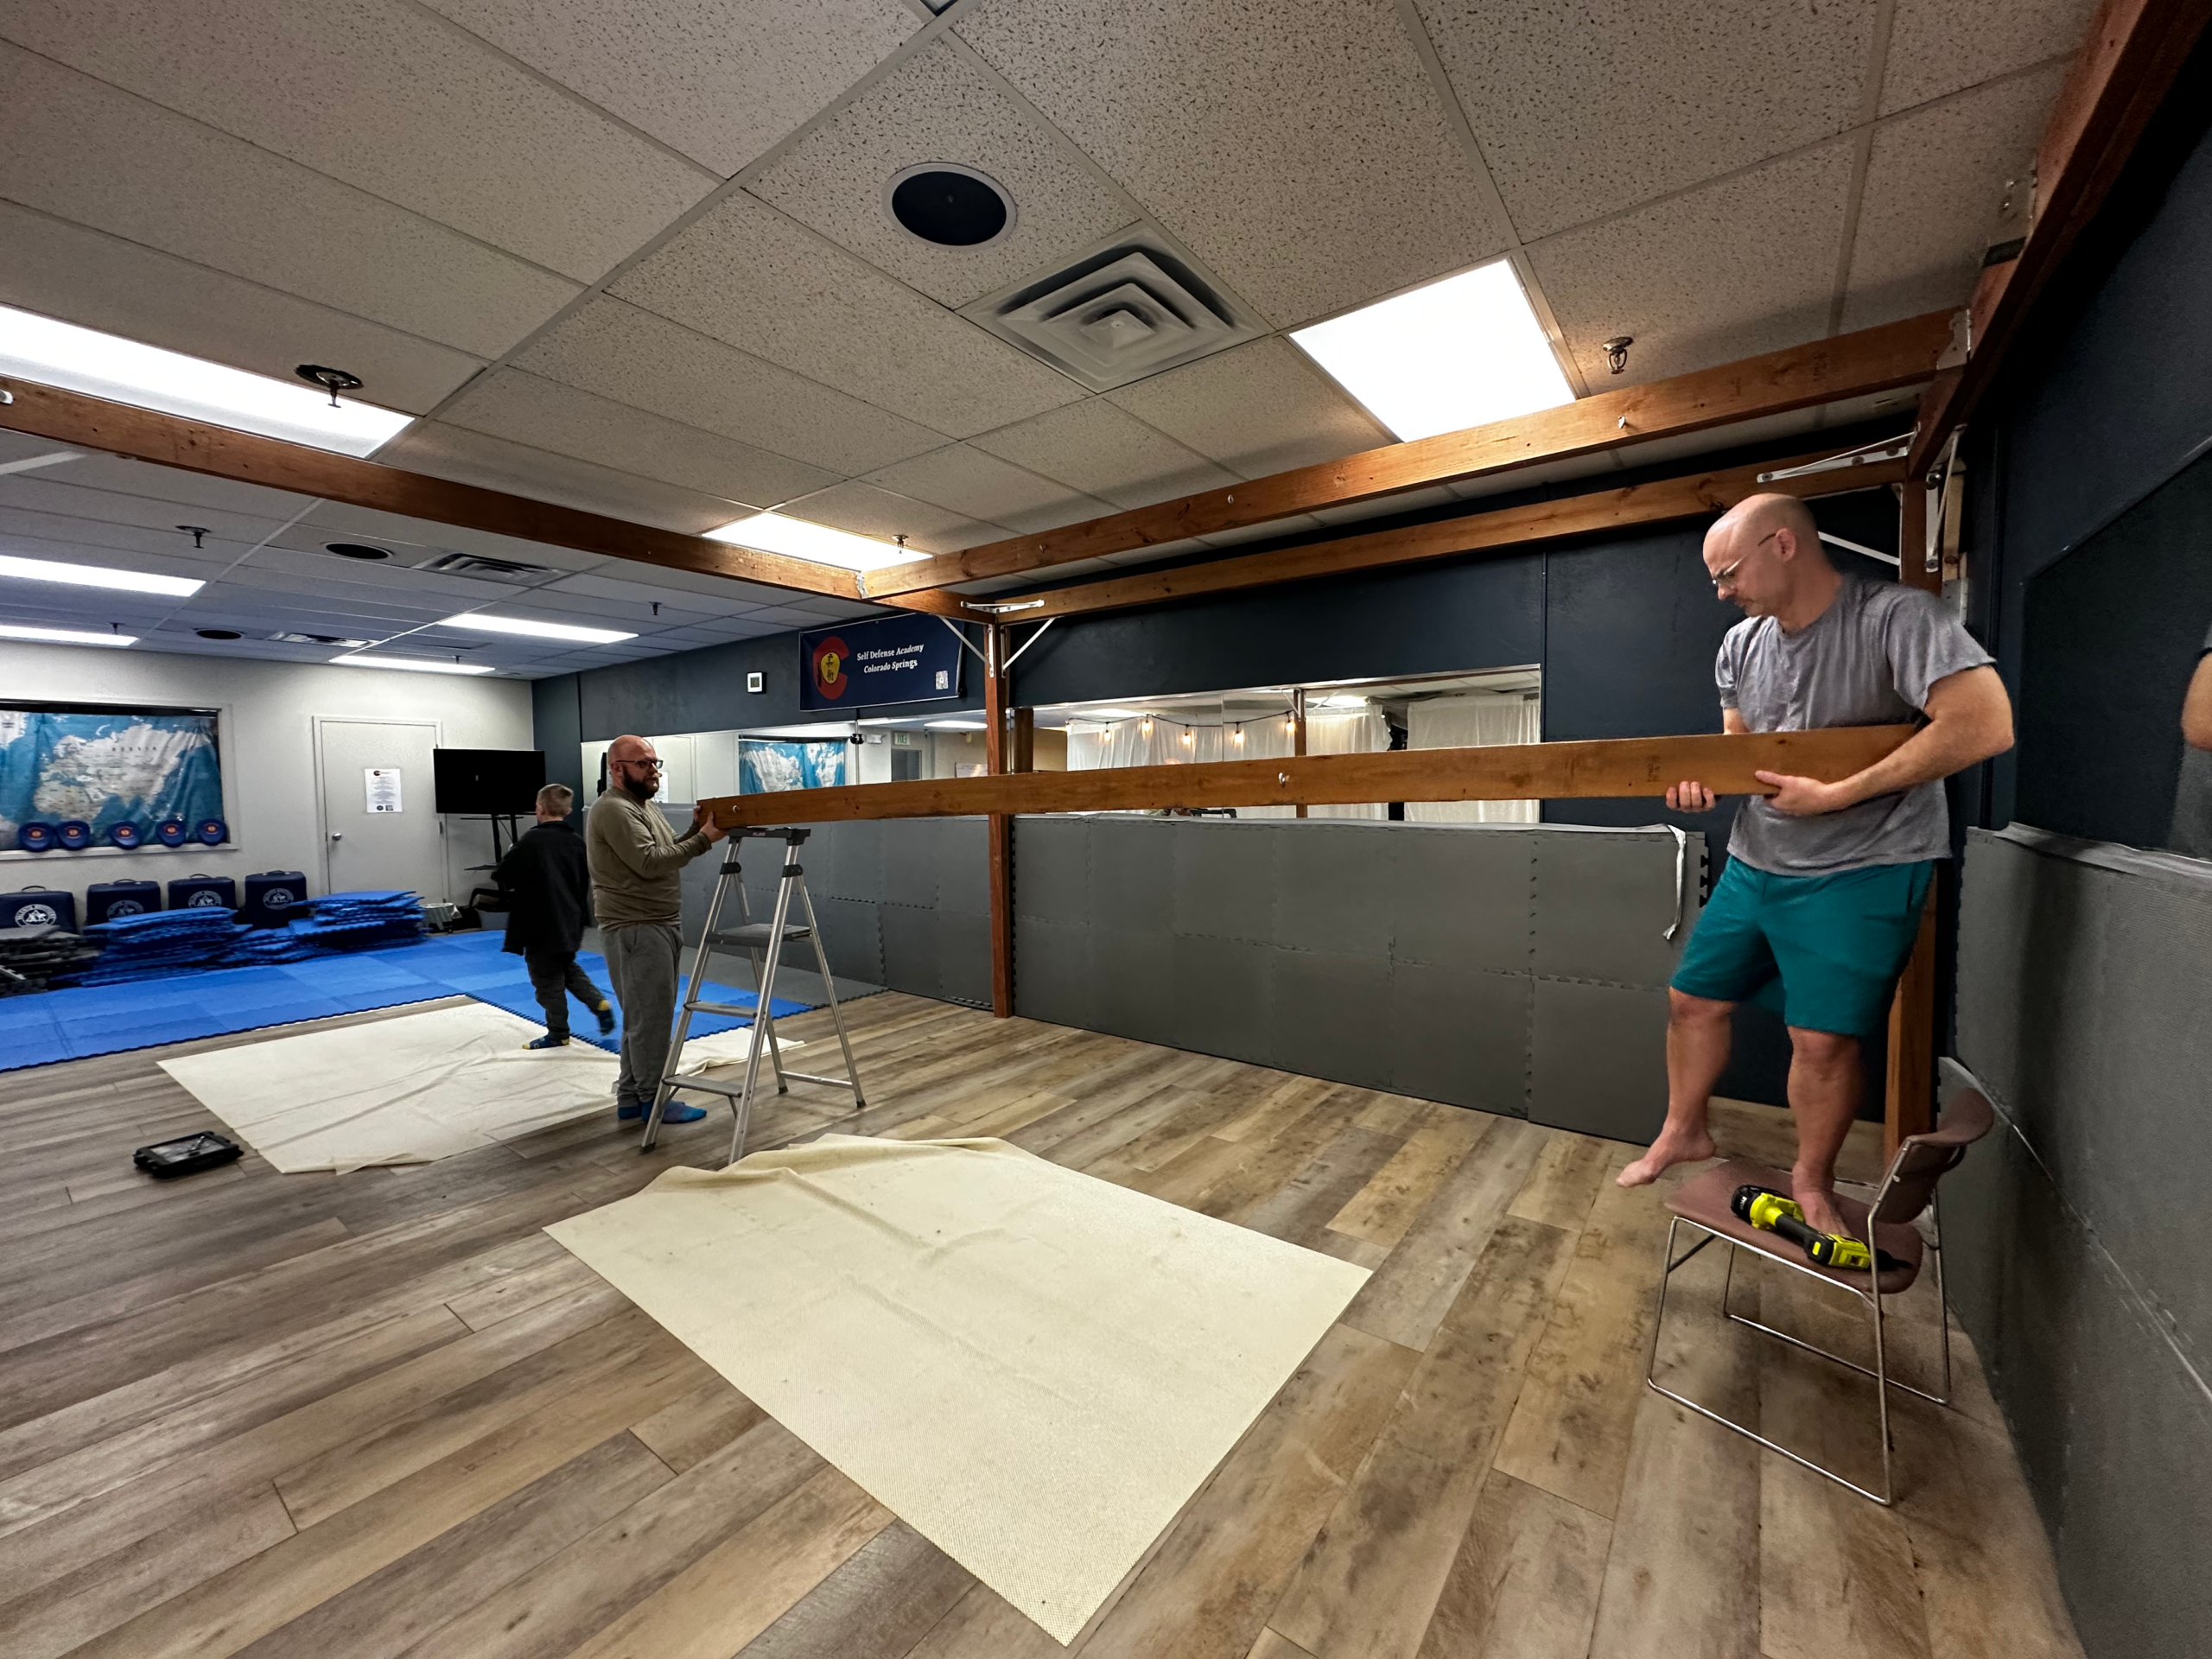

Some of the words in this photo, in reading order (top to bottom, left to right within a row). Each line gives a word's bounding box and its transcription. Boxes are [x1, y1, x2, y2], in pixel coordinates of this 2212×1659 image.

[857, 651, 869, 661] Self
[870, 649, 895, 659] Defense
[896, 644, 924, 655] Academy
[864, 663, 891, 673] Colorado
[892, 659, 918, 671] Springs
